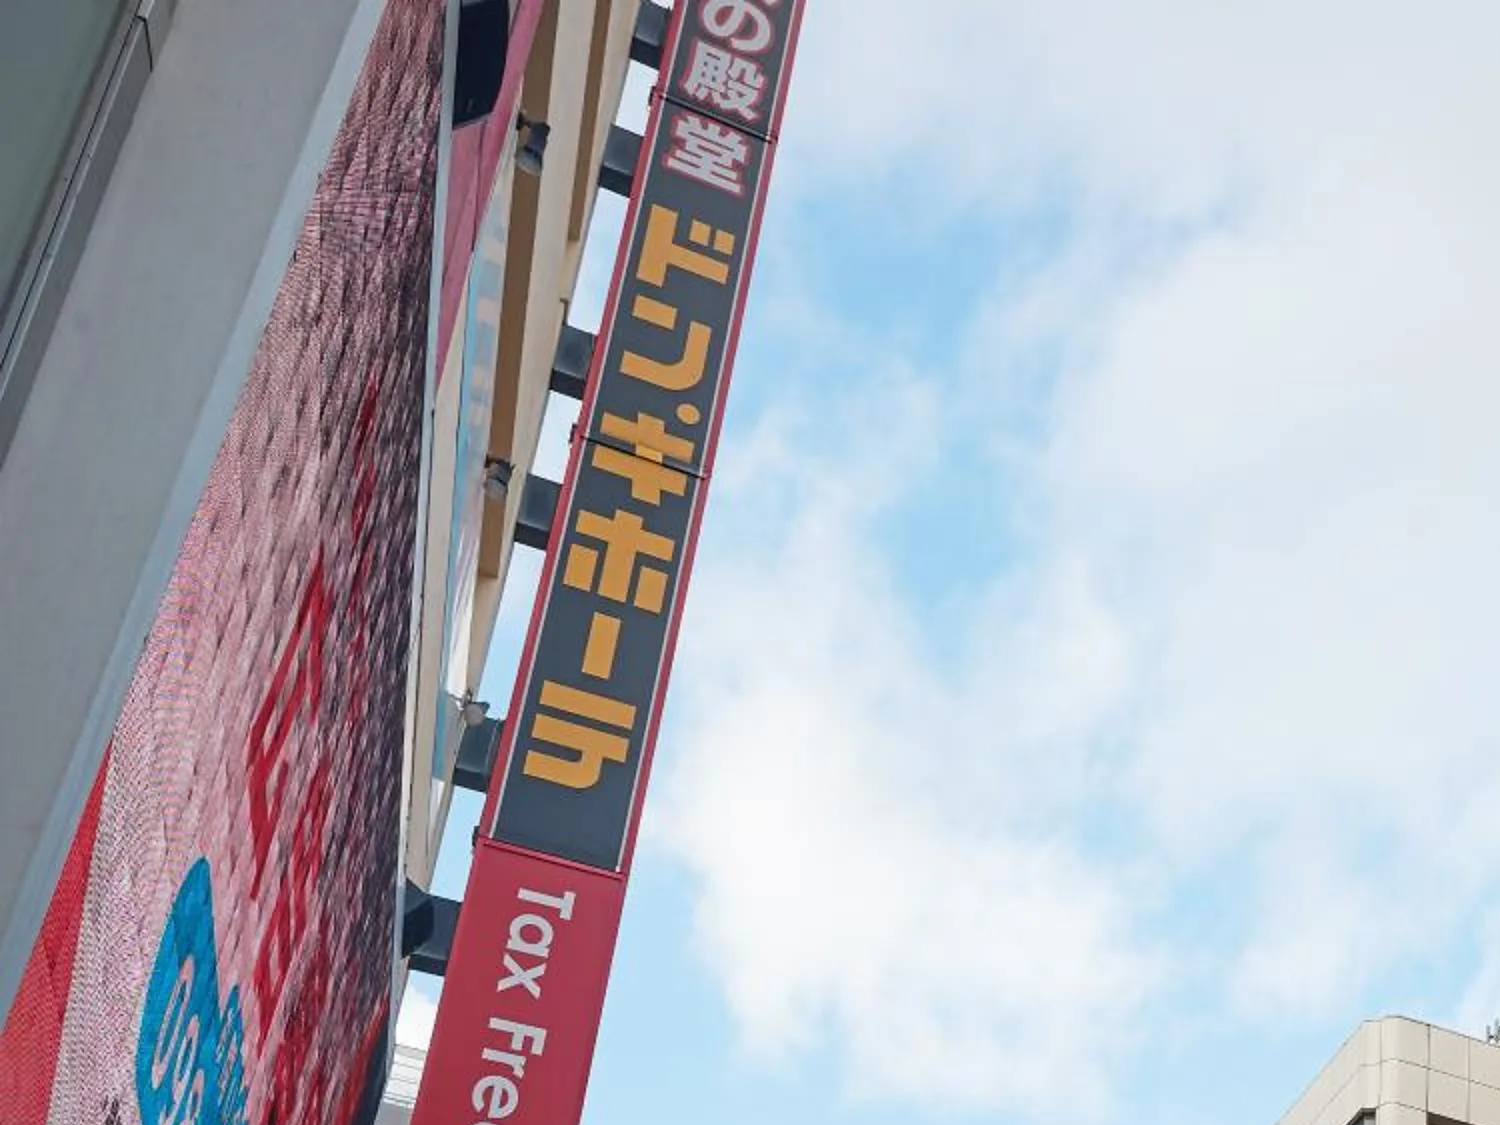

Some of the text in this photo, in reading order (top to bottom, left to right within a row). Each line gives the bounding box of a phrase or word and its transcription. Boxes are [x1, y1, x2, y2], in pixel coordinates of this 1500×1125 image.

[523, 0, 772, 790] の殿堂 ドン・キホーテ
[498, 888, 577, 999] Tax
